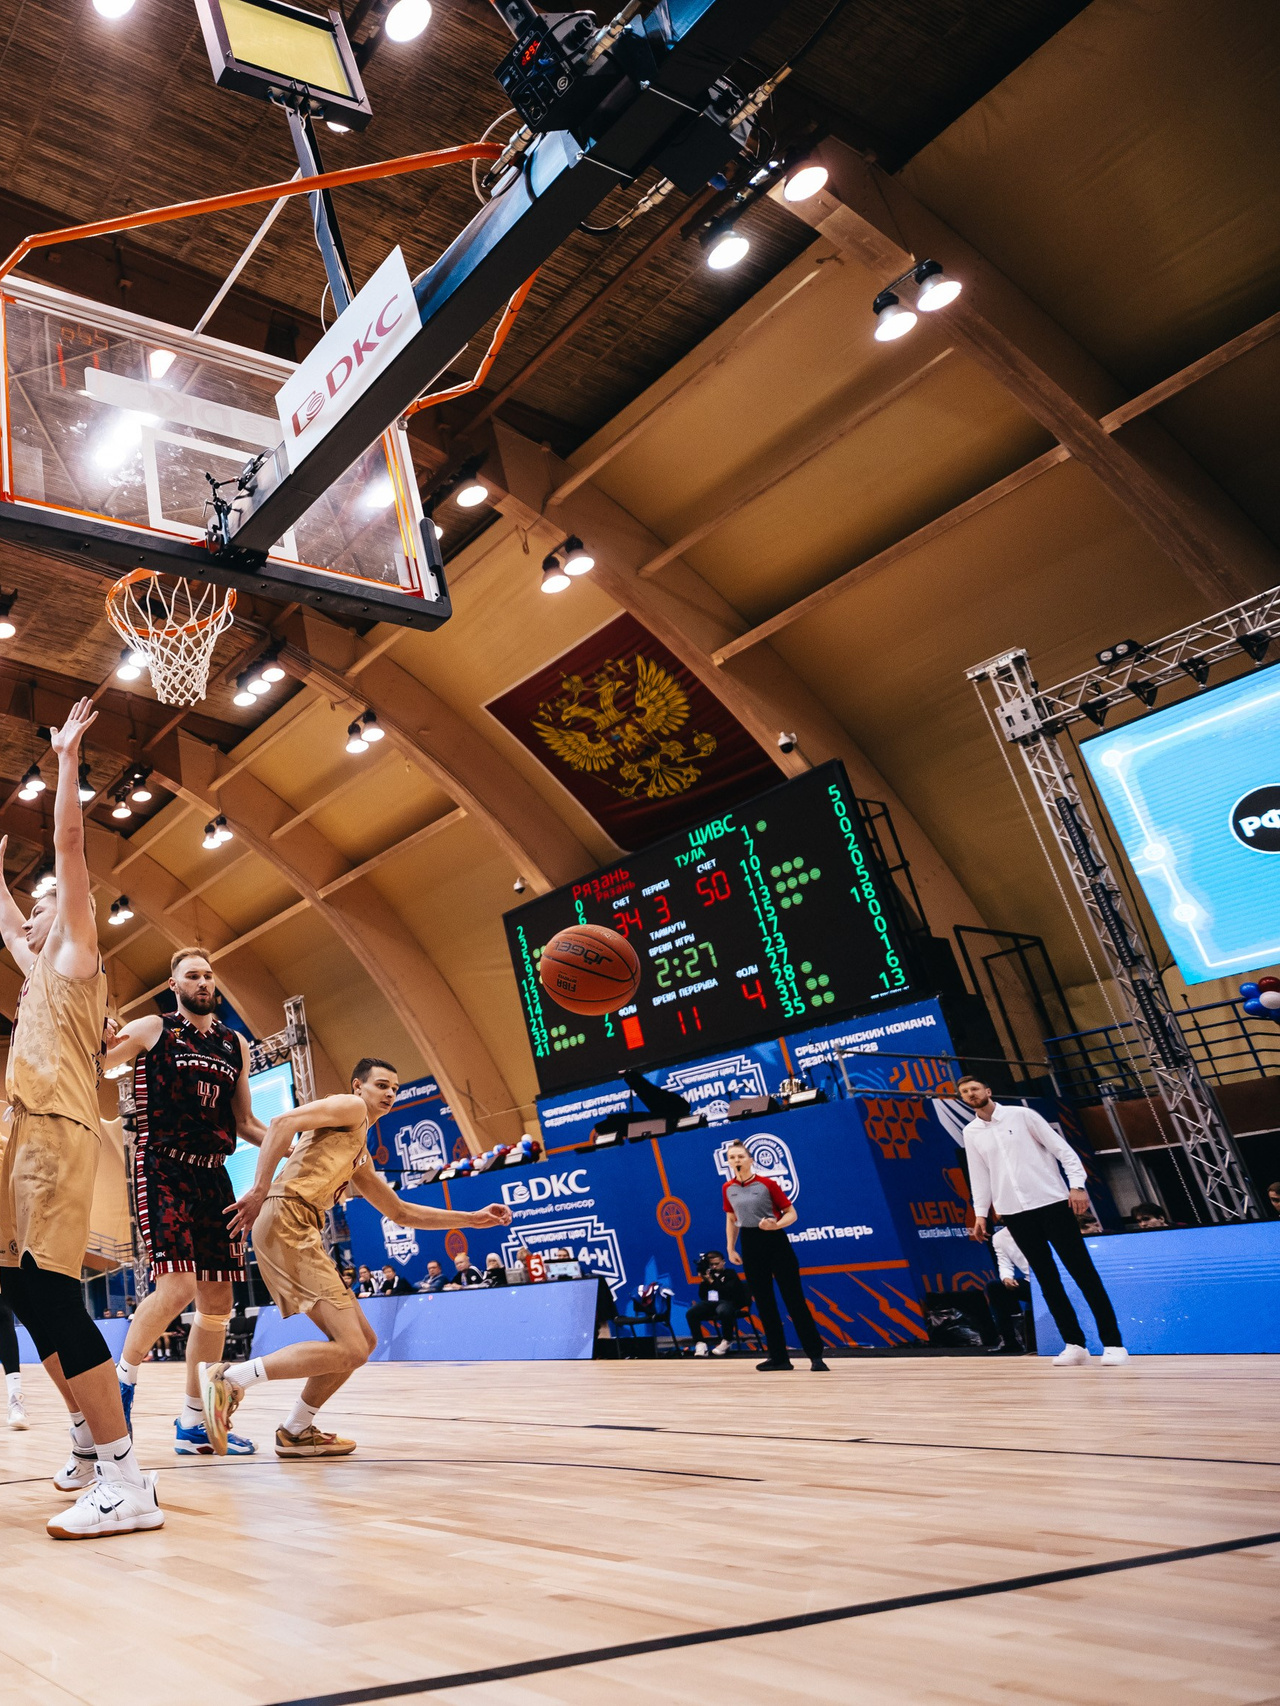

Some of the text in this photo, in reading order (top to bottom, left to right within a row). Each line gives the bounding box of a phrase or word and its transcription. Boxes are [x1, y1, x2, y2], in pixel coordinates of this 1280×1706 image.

[324, 294, 403, 398] DKC
[828, 784, 841, 802] 5
[834, 801, 846, 817] 0
[688, 813, 737, 848] ЦИВС
[740, 825, 750, 840] 1
[839, 817, 852, 833] 0
[744, 839, 754, 855] 7
[844, 833, 859, 851] 2
[674, 846, 706, 869] ТУЛА
[696, 858, 717, 874] СЧЕТ
[740, 855, 760, 874] 10
[850, 849, 863, 866] 0
[744, 870, 763, 889] 11
[856, 865, 869, 883] 5
[641, 878, 671, 898] ПЕРИОД
[695, 869, 731, 907] 50
[749, 885, 770, 905] 13
[575, 899, 584, 913] 0
[612, 895, 630, 910] СЧЕТ
[653, 895, 671, 925] 3
[753, 901, 775, 920] 15
[868, 899, 881, 916] 0
[578, 911, 587, 925] 6
[613, 908, 643, 938] 34
[758, 916, 778, 936] 17
[873, 916, 887, 933] 0
[517, 926, 526, 939] 2
[649, 919, 687, 941] ТАЙМАУТЫ
[521, 939, 528, 952] 3
[648, 933, 696, 957] ВРЕМЯ ИГРЫ
[762, 932, 786, 953] 23
[879, 932, 892, 950] 1
[522, 951, 531, 965] 5
[553, 941, 613, 965] JÖGEL
[767, 947, 788, 969] 27
[886, 950, 899, 968] 6
[525, 964, 534, 977] 9
[654, 941, 718, 988] 2:27
[735, 964, 759, 978] ФОЛЫ
[772, 963, 796, 985] 28
[879, 968, 906, 989] 13
[521, 976, 536, 992] 12
[557, 978, 577, 992] FIBA
[652, 978, 719, 1007] ВРЕМЯ ПЕРЕРЫВА
[777, 980, 799, 1001] 31
[524, 990, 540, 1005] 13
[741, 979, 767, 1010] 4
[527, 1003, 543, 1018] 14
[618, 1004, 638, 1017] ФОЛЫ
[782, 997, 806, 1018] 35
[530, 1015, 545, 1032] 21
[677, 1006, 702, 1035] 11
[532, 1029, 549, 1045] 33
[604, 1023, 615, 1038] 2
[794, 1014, 937, 1057] СРЕДИ МУЖСКИХ КОМАНД
[536, 1042, 550, 1058] 41
[197, 1080, 220, 1109] 41
[680, 1080, 726, 1104] ИНАЛ
[542, 1101, 583, 1118] ЧЕМПИОНАТ
[544, 1101, 627, 1128] ФЕДЕРАЛЬНОГО ОКРУГА
[528, 1169, 591, 1201] DKC
[512, 1198, 595, 1219] итульный спонсор
[909, 1201, 965, 1227] ЦЕЛЬ
[525, 1231, 568, 1244] ЧЕМПИОНАТ
[918, 1226, 952, 1238] ЮБИЛЕЙНЫЙ
[385, 1241, 420, 1258] ТВЕРЬ
[529, 1258, 543, 1276] 5
